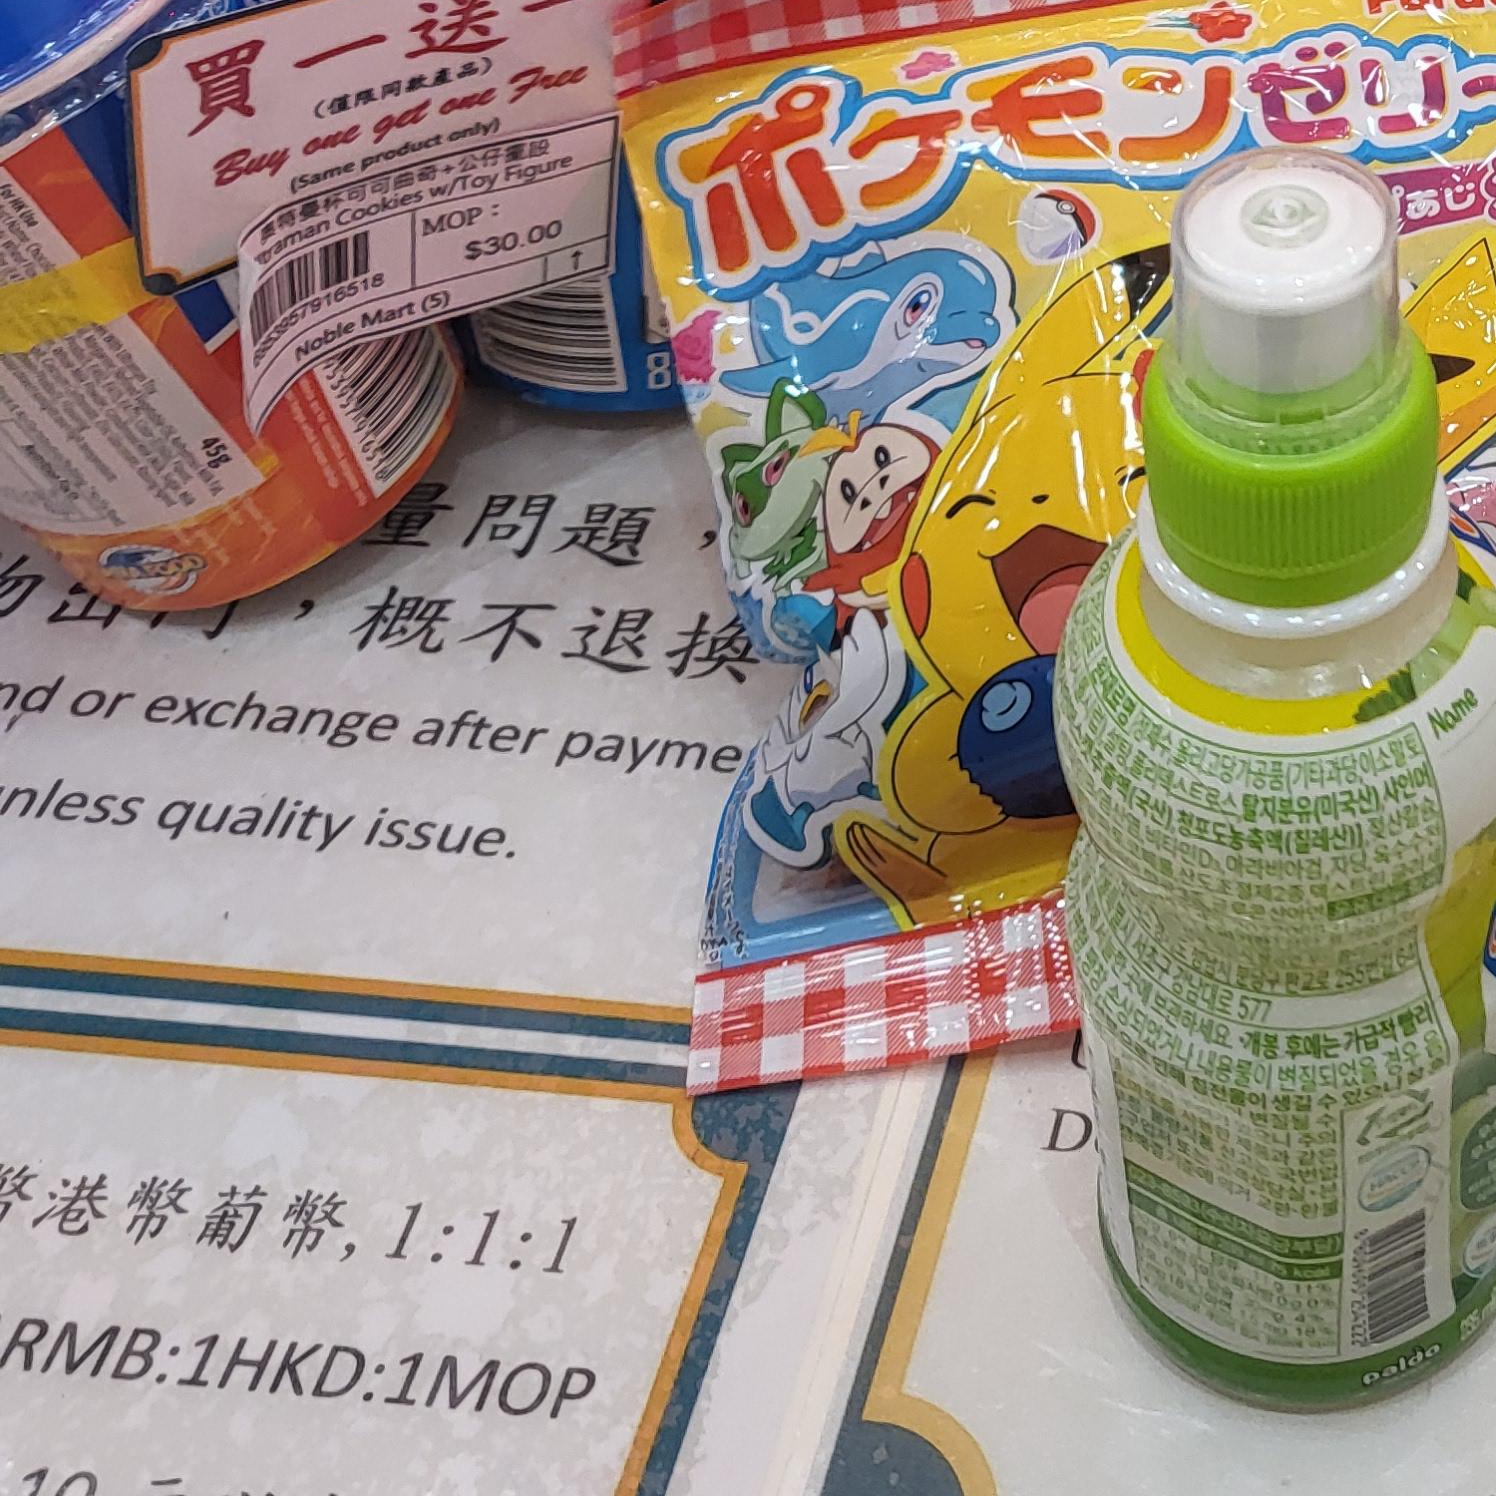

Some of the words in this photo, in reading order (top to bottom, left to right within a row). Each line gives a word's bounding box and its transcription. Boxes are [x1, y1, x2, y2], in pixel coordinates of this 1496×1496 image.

[212, 144, 291, 190] Buy
[302, 121, 363, 155] one
[373, 105, 430, 143] get
[439, 83, 497, 117] one
[506, 64, 590, 106] Free
[358, 132, 446, 176] product
[334, 188, 425, 228] Cookies
[503, 153, 575, 189] Figure
[463, 218, 565, 262] $30.00
[294, 315, 357, 364] Noble
[358, 300, 417, 331] Mart
[70, 688, 136, 719] or
[144, 690, 399, 749] exchange
[413, 707, 548, 758] after
[556, 725, 743, 777] payme
[1426, 687, 1480, 741] Name
[0, 777, 146, 827] nless
[157, 796, 356, 853] quality
[365, 805, 518, 861] issue.
[1237, 994, 1273, 1023] 577
[1361, 1342, 1442, 1386] paldo
